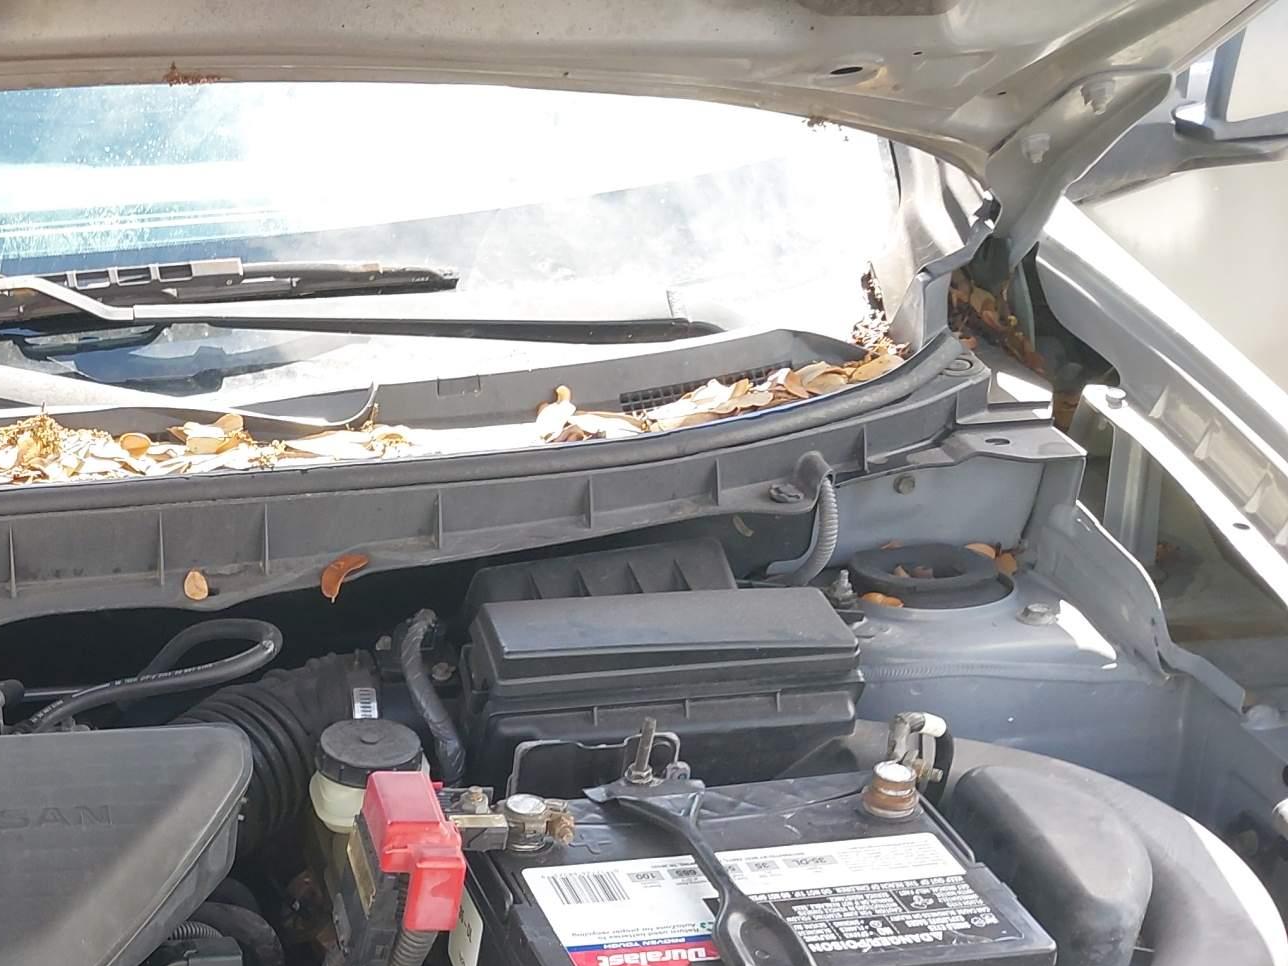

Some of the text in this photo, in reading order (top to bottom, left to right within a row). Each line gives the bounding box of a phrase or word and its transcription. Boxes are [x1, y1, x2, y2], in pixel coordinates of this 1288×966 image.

[635, 872, 656, 880] 100
[642, 937, 686, 945] PROVEN
[808, 931, 934, 953] DANGER/POISON
